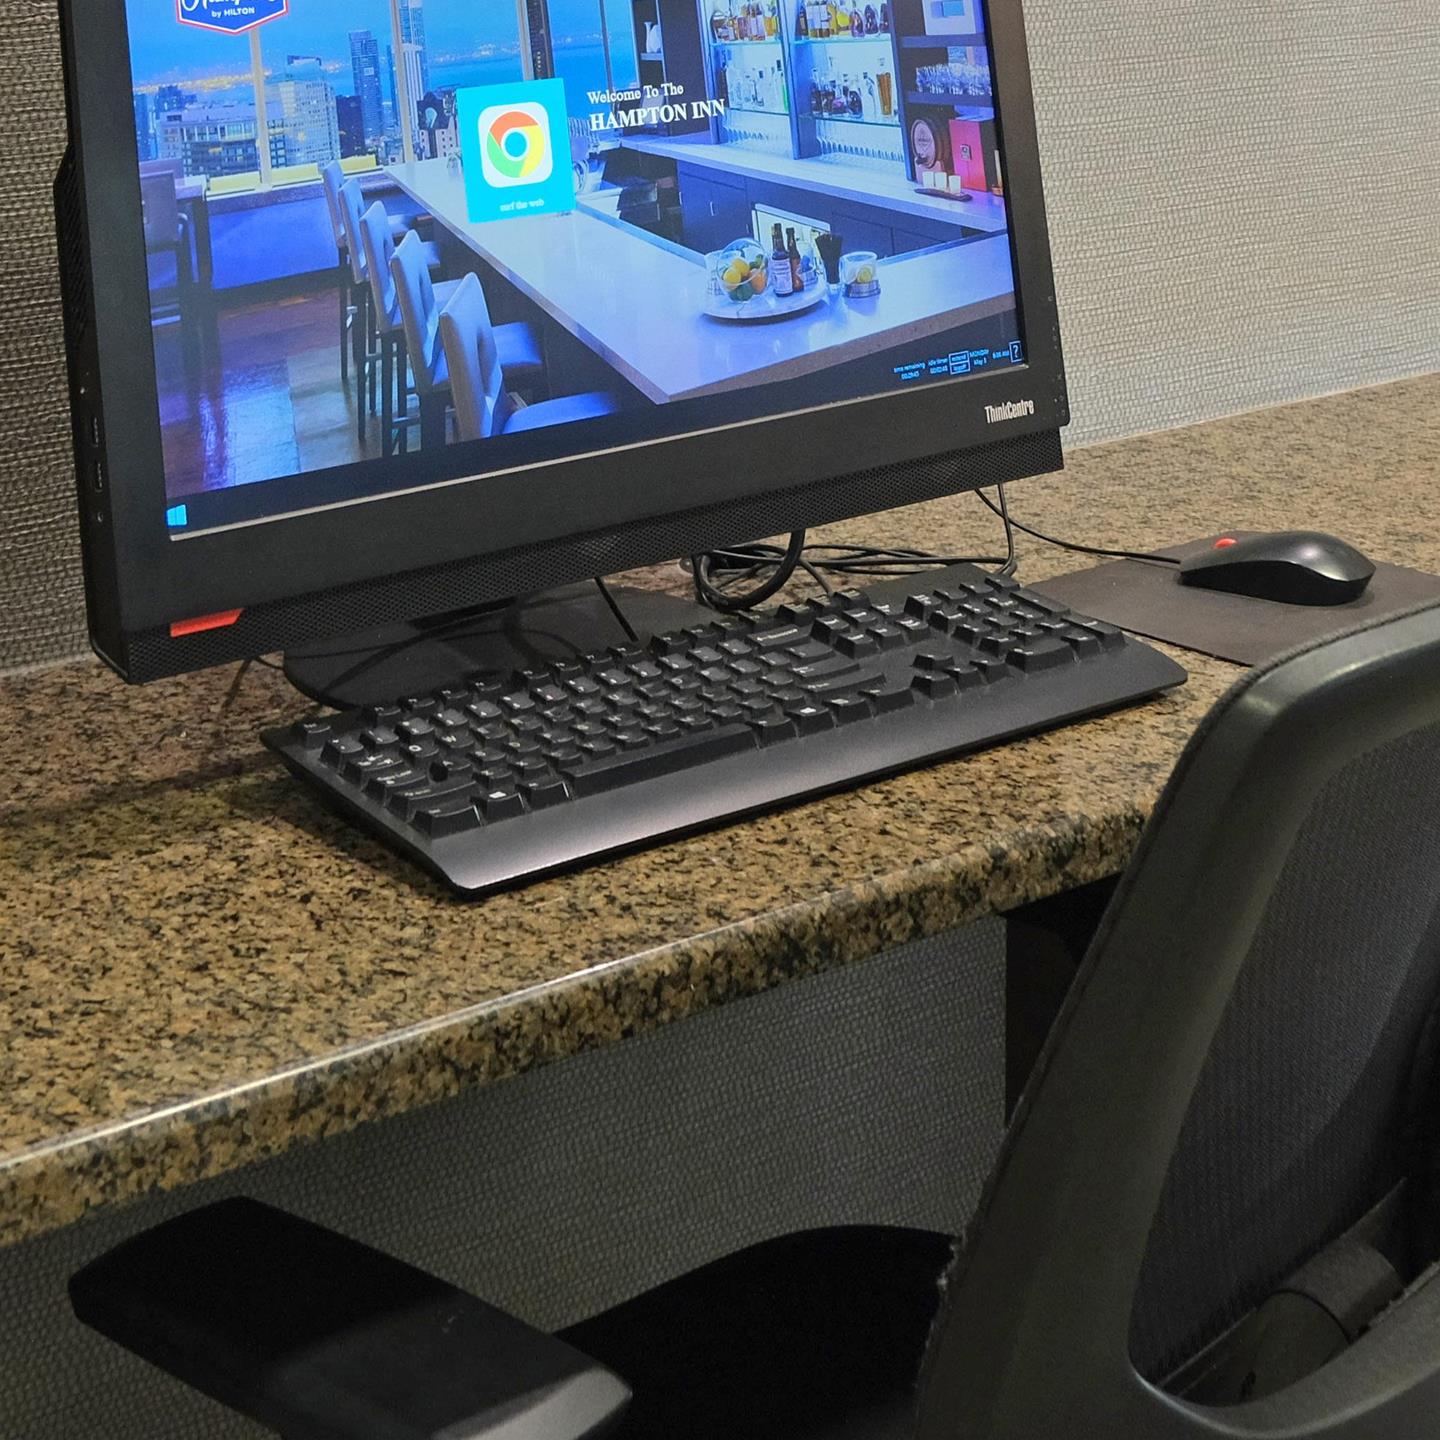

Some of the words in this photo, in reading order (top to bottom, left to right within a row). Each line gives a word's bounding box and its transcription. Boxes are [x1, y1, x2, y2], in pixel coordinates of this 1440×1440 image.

[211, 10, 221, 18] by
[223, 7, 255, 16] HILTON
[587, 90, 641, 104] Welcome
[643, 85, 659, 98] To
[661, 82, 684, 96] The
[589, 103, 688, 131] HAMPTON
[691, 99, 725, 119] INN
[984, 399, 1034, 424] ThinkCentre
